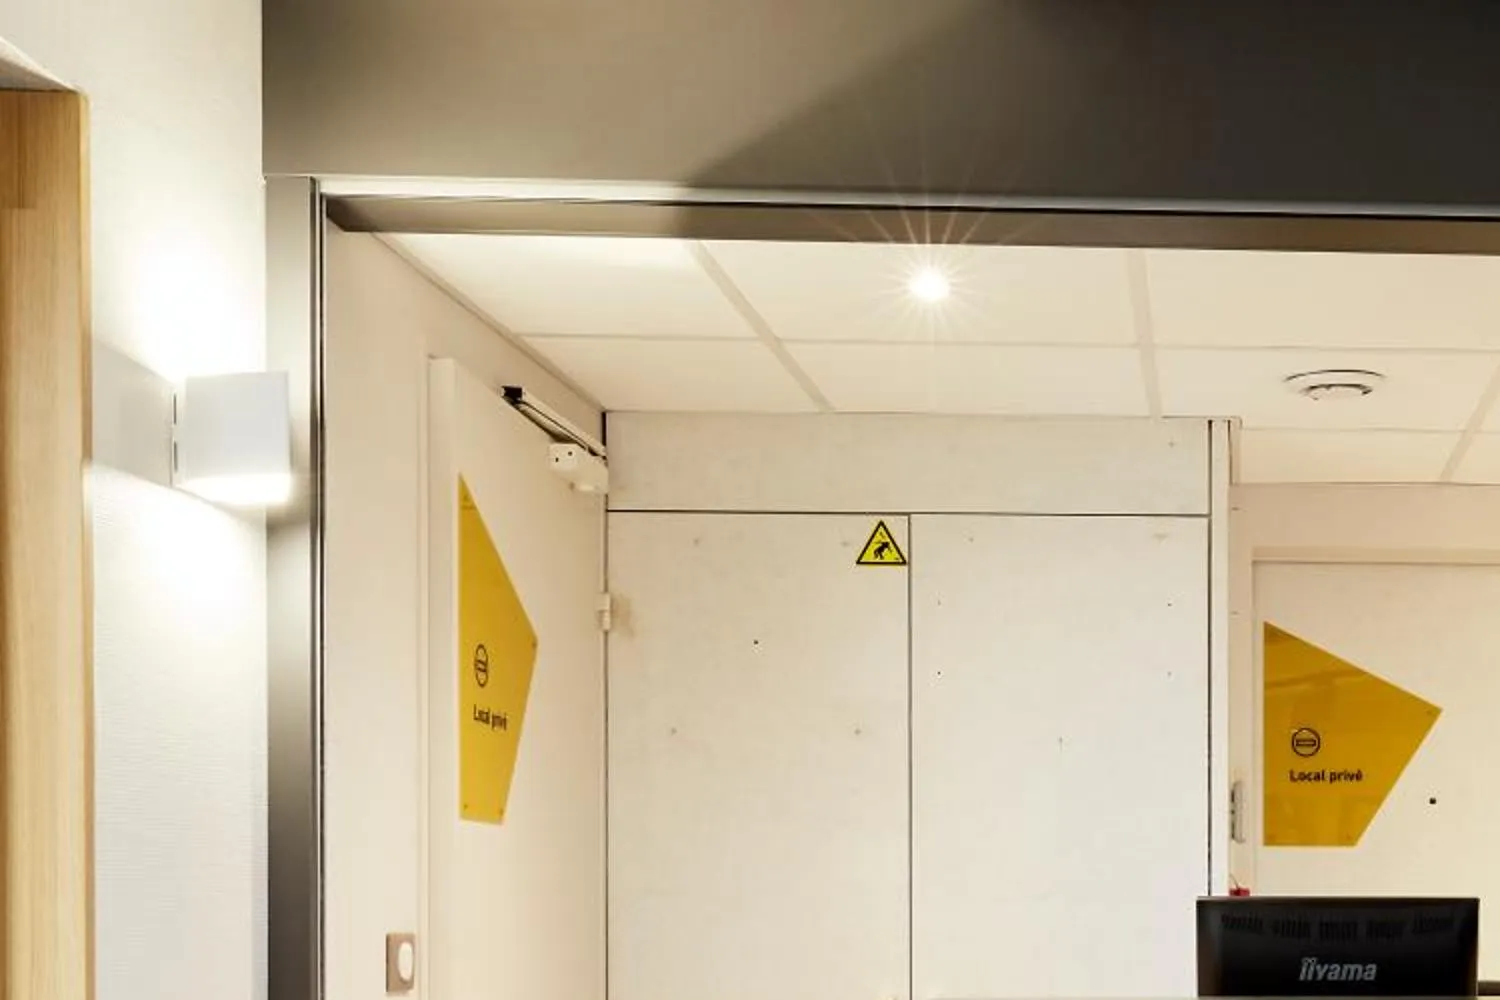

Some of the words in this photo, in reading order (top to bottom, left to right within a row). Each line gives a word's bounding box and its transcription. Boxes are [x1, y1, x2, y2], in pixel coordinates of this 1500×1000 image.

[1289, 769, 1325, 783] Local
[1329, 769, 1364, 784] privé
[1300, 957, 1377, 981] iiyama
